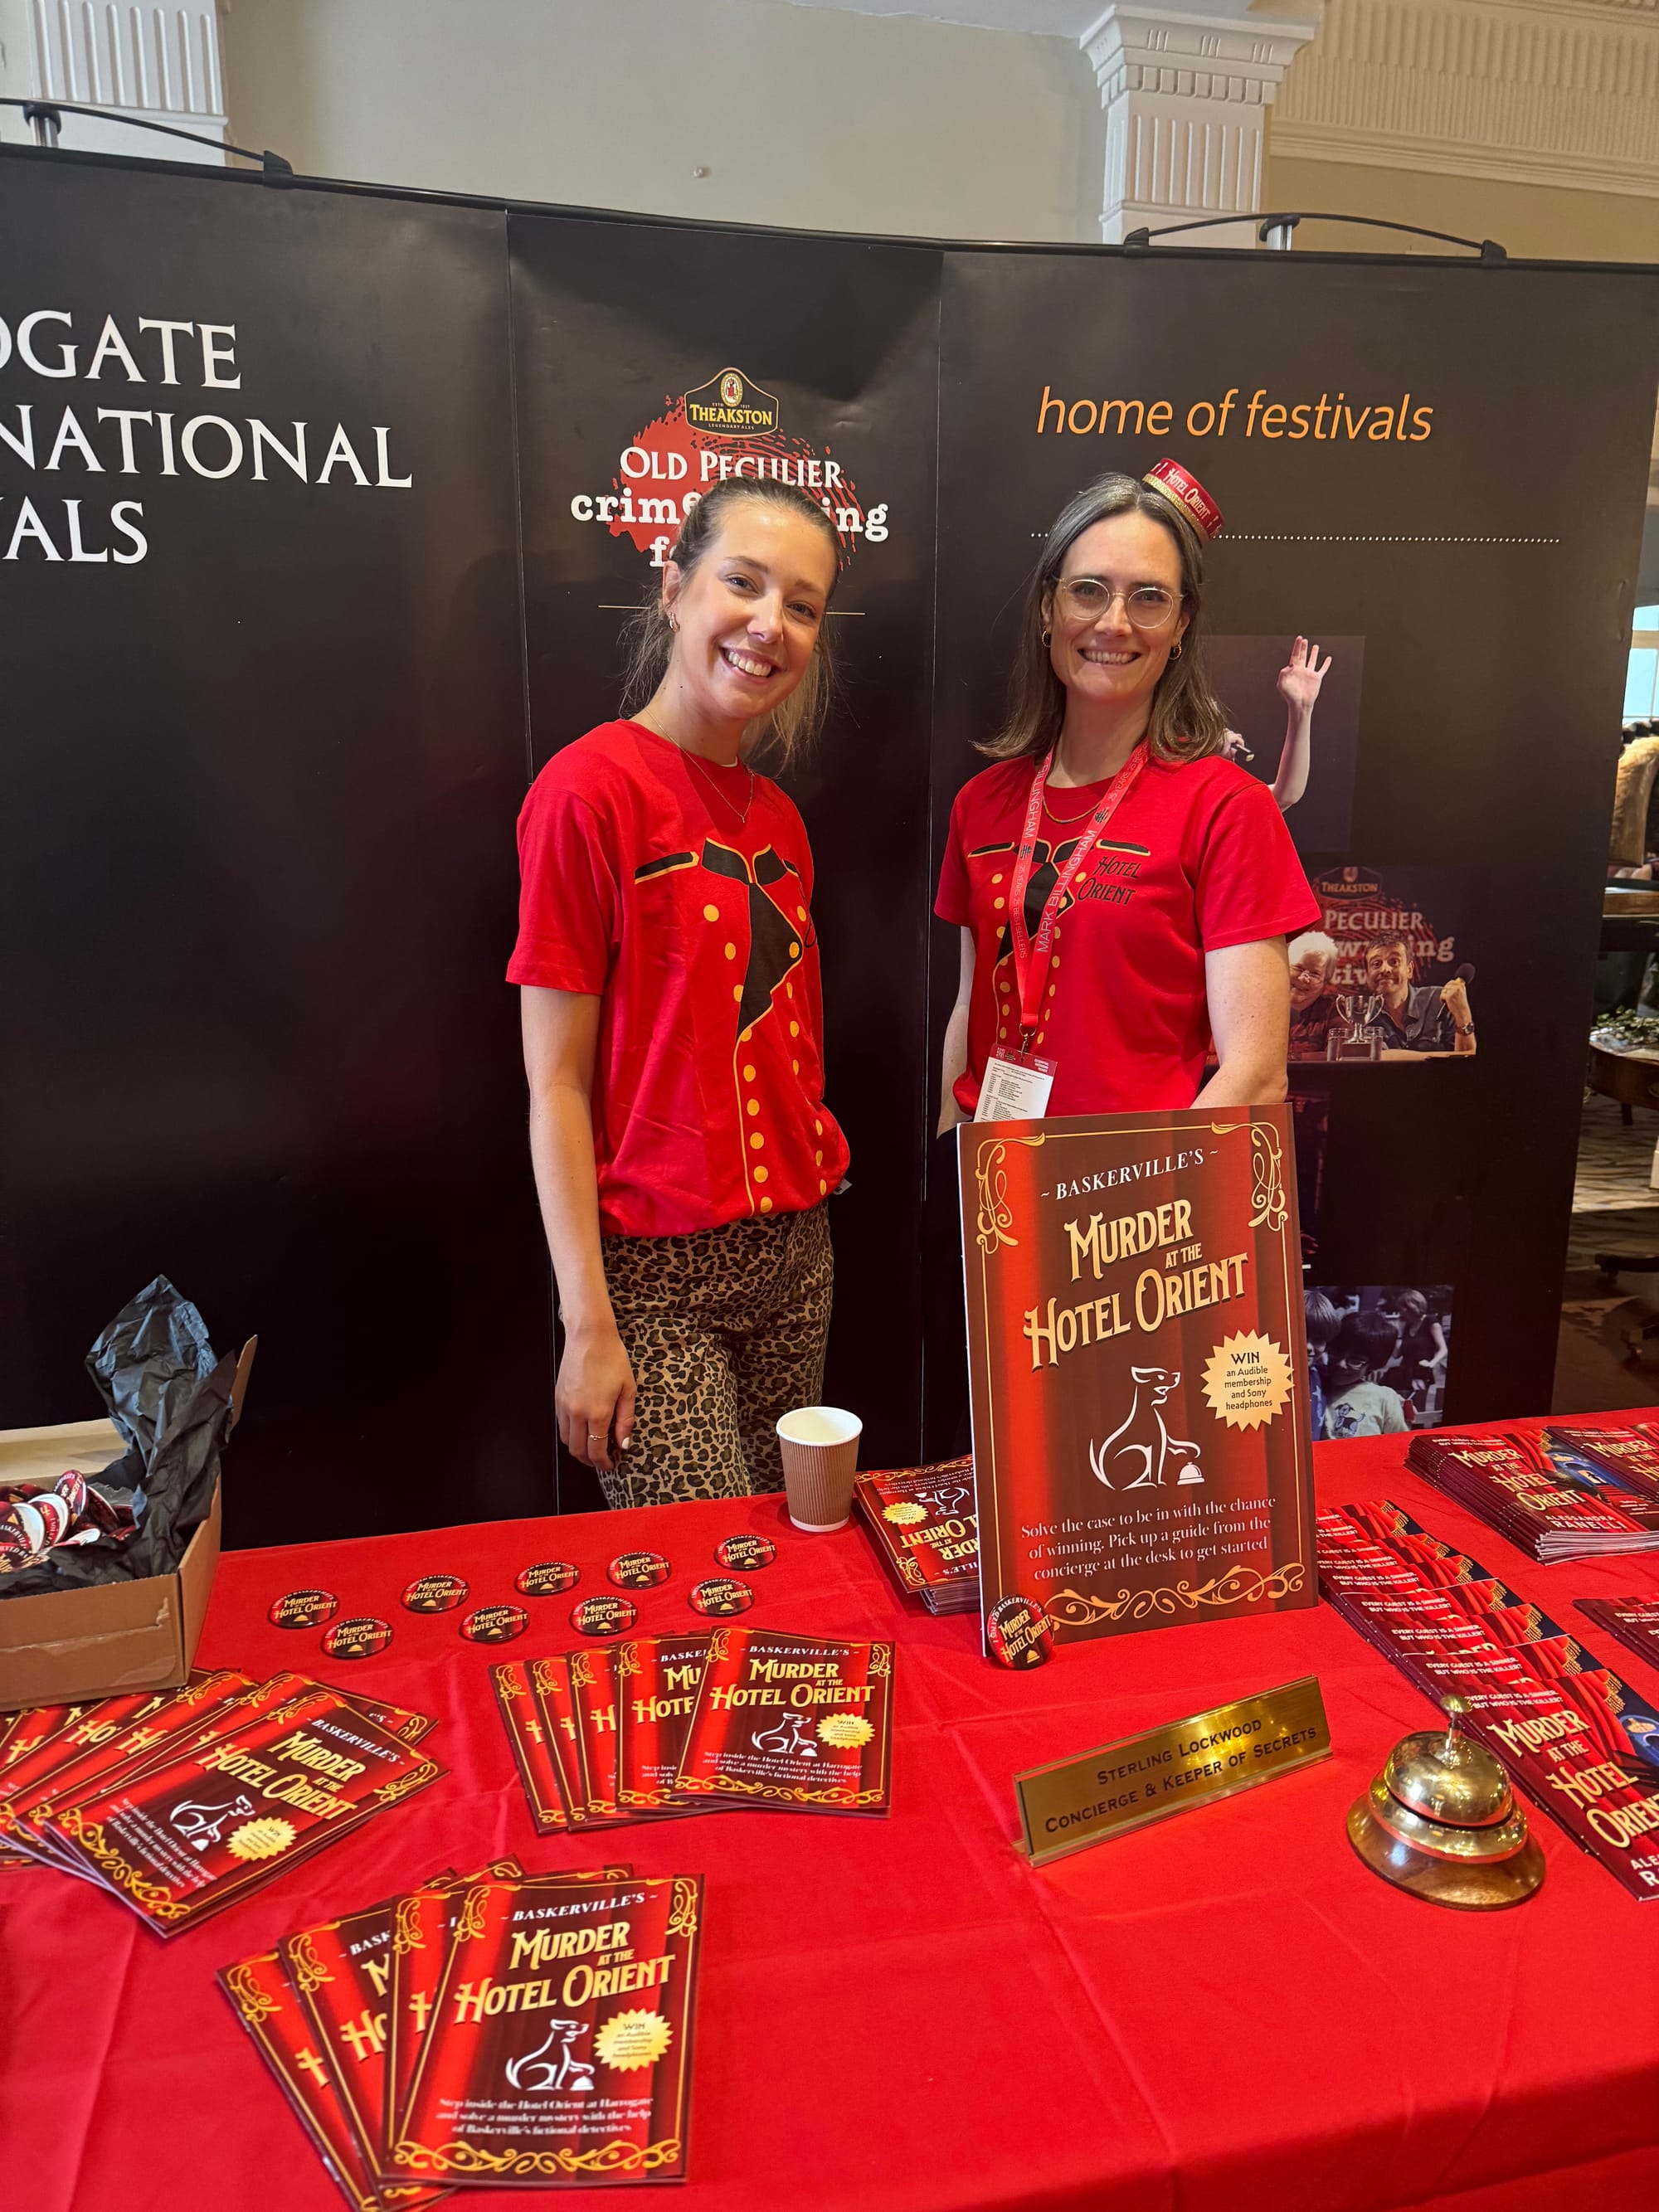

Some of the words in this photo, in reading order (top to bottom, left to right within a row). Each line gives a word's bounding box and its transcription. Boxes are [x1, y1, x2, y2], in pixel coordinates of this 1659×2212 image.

[0, 310, 241, 390] GATE
[689, 403, 772, 425] THEAKSTON
[1037, 386, 1173, 435] home
[1186, 387, 1239, 438] of
[1244, 389, 1433, 442] festivals
[620, 446, 688, 481] OLD
[700, 450, 844, 489] PECULIER
[1163, 468, 1189, 495] HOTEL
[1185, 488, 1211, 520] ORIENT
[0, 496, 148, 564] ALS
[1092, 856, 1141, 879] HOTEL
[1036, 911, 1054, 953] MARK
[1048, 829, 1097, 907] BILLINGHAM
[1078, 877, 1136, 906] ORIENT
[1321, 881, 1379, 893] THEAKSTON
[1324, 909, 1425, 931] PECULIER
[1013, 907, 1028, 959] BESTSELLERS
[1055, 1148, 1205, 1201] BASKERVILLE'S
[1064, 1199, 1194, 1282] MURDER
[1165, 1248, 1181, 1269] AT
[1181, 1242, 1203, 1266] THE
[1024, 1292, 1131, 1371] HOTEL
[1135, 1252, 1248, 1333] ORIENT
[1231, 1351, 1260, 1364] WIN
[1238, 1365, 1268, 1376] Audible
[1224, 1377, 1272, 1388] membership
[1231, 1389, 1246, 1398] and
[1247, 1388, 1267, 1398] Sony
[1225, 1400, 1273, 1411] headphones
[1448, 1447, 1525, 1468] MURDER
[1583, 1440, 1656, 1458] MURDER
[1491, 1462, 1506, 1471] AT
[1506, 1461, 1523, 1471] THE
[1489, 1472, 1557, 1492] HOTEL
[1516, 1489, 1586, 1511] ORIENT
[1021, 1522, 1058, 1539] Solve
[1062, 1519, 1083, 1534] the
[1087, 1517, 1116, 1530] case
[1120, 1514, 1133, 1526] to
[1136, 1510, 1153, 1524] be
[1156, 1508, 1170, 1521] in
[1173, 1503, 1201, 1519] with
[1205, 1500, 1227, 1514] the
[1229, 1498, 1277, 1512] chance
[1545, 1514, 1616, 1523] ALESSANDRA
[1551, 1520, 1627, 1529] RANELLI
[900, 1519, 966, 1548] ORIENT
[1029, 1544, 1045, 1559] of
[1047, 1539, 1105, 1555] winning.
[1109, 1532, 1136, 1548] Pick
[1140, 1533, 1158, 1548] up
[1160, 1532, 1169, 1541] a
[1172, 1523, 1210, 1544] guide
[1214, 1520, 1245, 1534] from
[1249, 1516, 1271, 1530] the
[722, 1549, 749, 1563] HOTEL
[748, 1544, 776, 1557] ORIENT
[726, 1540, 758, 1553] MURDER
[618, 1556, 651, 1569] MURDER
[1034, 1562, 1101, 1581] concierge
[1103, 1558, 1116, 1570] at
[1121, 1553, 1142, 1568] the
[1145, 1548, 1176, 1564] desk
[1180, 1548, 1194, 1560] to
[1197, 1544, 1218, 1562] get
[1220, 1536, 1267, 1554] started
[521, 1575, 548, 1588] HOTEL
[548, 1569, 579, 1582] ORIENT
[528, 1565, 562, 1578] MURDER
[614, 1567, 642, 1580] HOTEL
[641, 1560, 670, 1573] ORIENT
[406, 1591, 434, 1602] HOTEL
[435, 1587, 469, 1599] ORIENT
[417, 1582, 452, 1591] MURDER
[700, 1584, 733, 1598] MURDER
[275, 1605, 304, 1620] HOTEL
[304, 1599, 338, 1613] ORIENT
[284, 1595, 319, 1607] MURDER
[583, 1602, 618, 1616] MURDER
[698, 1595, 725, 1609] HOTEL
[724, 1588, 753, 1602] ORIENT
[997, 1597, 1042, 1613] BASKERVILLE'S
[466, 1621, 496, 1636] HOTEL
[496, 1612, 529, 1626] ORIENT
[474, 1609, 508, 1622] MURDER
[577, 1613, 606, 1627] HOTEL
[606, 1607, 637, 1621] ORIENT
[998, 1609, 1031, 1641] MURDER
[327, 1634, 358, 1650] HOTEL
[358, 1628, 392, 1643] ORIENT
[337, 1623, 374, 1637] MURDER
[1000, 1636, 1029, 1663] HOTEL
[1024, 1614, 1052, 1644] ORIENT
[749, 1645, 850, 1657] BASKERVILLE'S
[748, 1658, 839, 1680] MURDER
[1493, 1664, 1523, 1673] KILLER?
[709, 1682, 787, 1711] HOTEL
[791, 1685, 876, 1709] ORIENT
[311, 1717, 401, 1764] BASKERVILLE'S
[1486, 1710, 1590, 1757] MURDER
[266, 1731, 366, 1783] MURDER
[1097, 1750, 1173, 1786] STERLING
[1178, 1719, 1262, 1757] LOCKWOOD
[1546, 1747, 1563, 1762] AT
[1561, 1740, 1589, 1757] THE
[194, 1743, 272, 1796] HOTEL
[266, 1773, 358, 1821] ORIENT
[314, 1776, 329, 1790] AT
[324, 1779, 341, 1793] THE
[1045, 1791, 1140, 1832] CONCIERGE
[1145, 1783, 1157, 1797] &
[1163, 1761, 1223, 1791] KEEPER
[1228, 1751, 1247, 1767] OF
[1253, 1727, 1317, 1758] SECRETS
[1545, 1762, 1639, 1809] HOTEL
[512, 1892, 645, 1922] BASKERVILLE'S
[509, 1921, 631, 1971] MURDER
[597, 1952, 613, 1966] AT
[613, 1948, 635, 1964] THE
[454, 1977, 557, 2025] HOTEL
[563, 1954, 675, 2007] ORIENT
